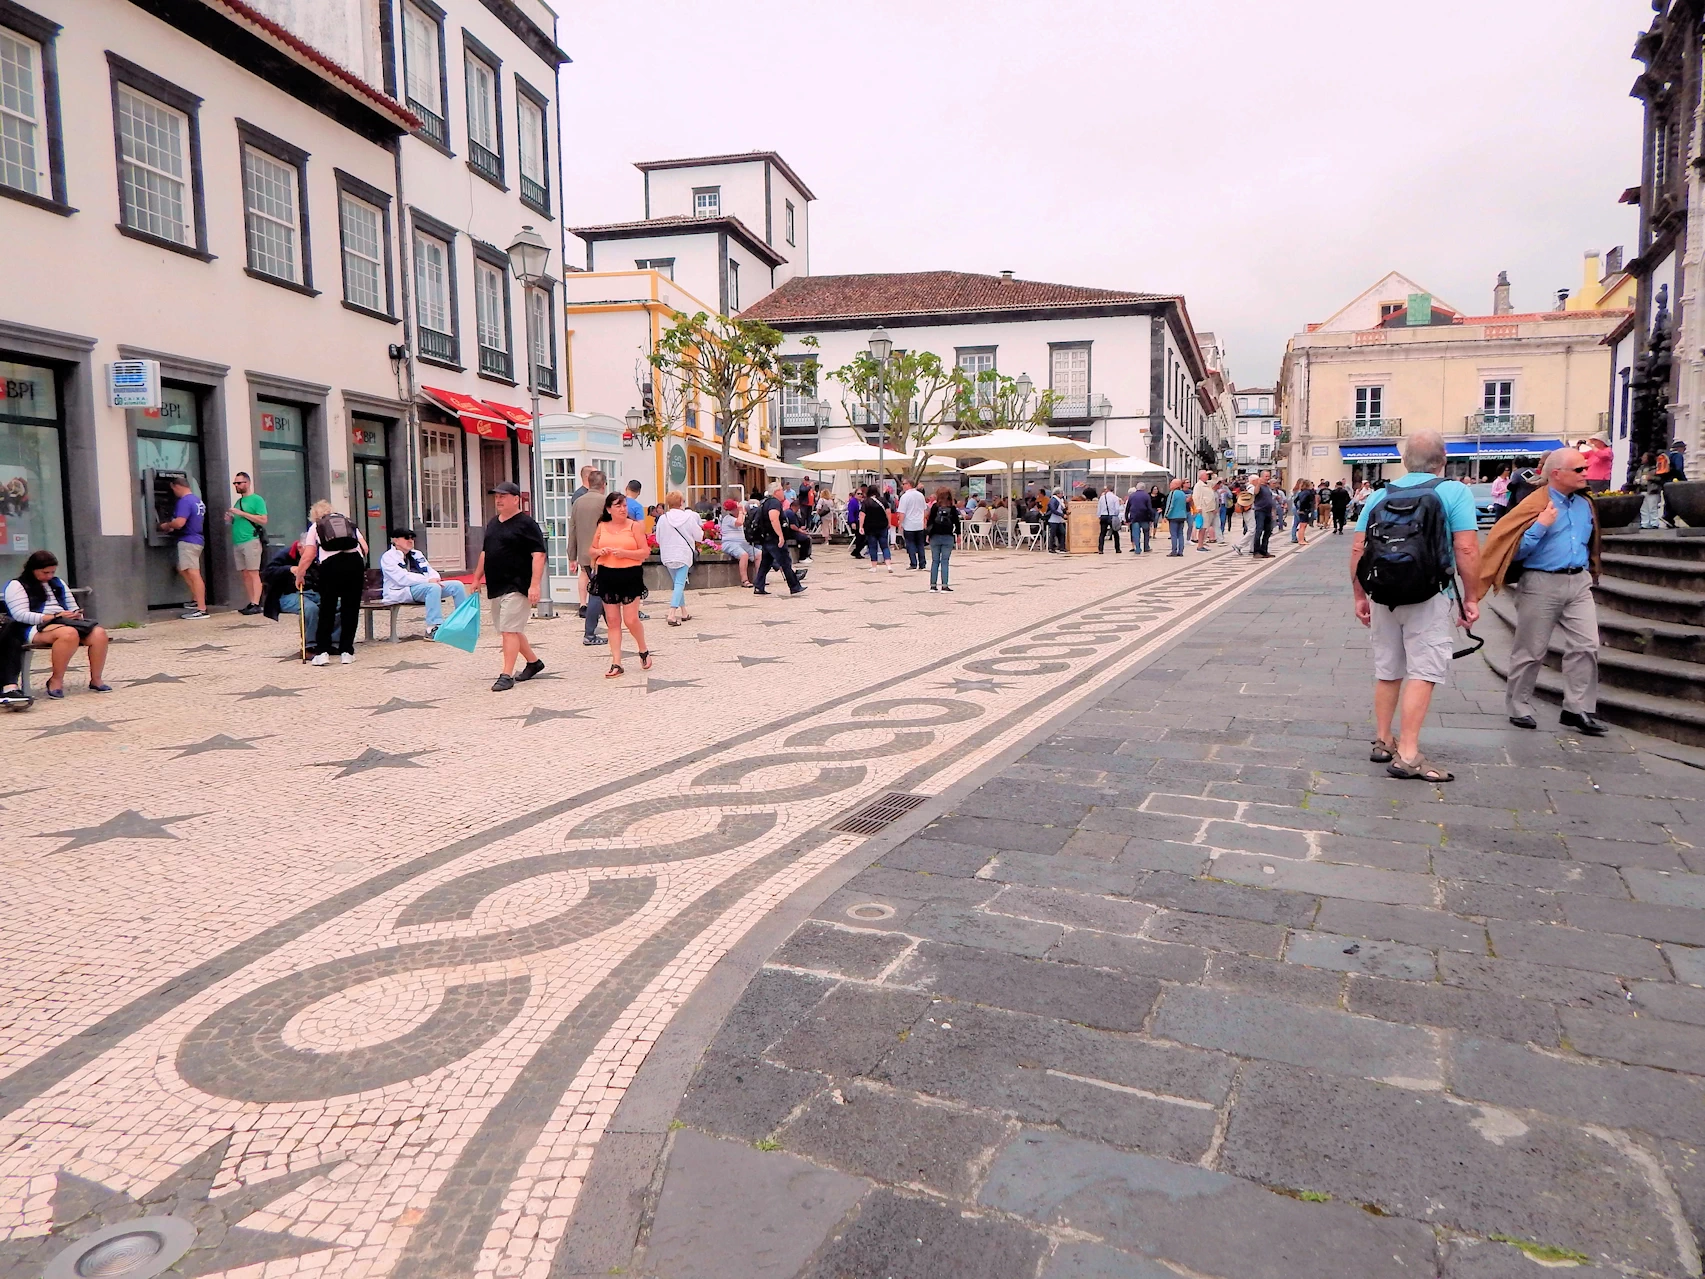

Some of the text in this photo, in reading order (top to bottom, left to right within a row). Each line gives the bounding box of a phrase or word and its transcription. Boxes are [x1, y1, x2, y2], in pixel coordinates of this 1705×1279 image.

[6, 380, 35, 400] BPI
[160, 401, 181, 418] BPI
[274, 416, 291, 431] BPI
[364, 431, 376, 443] BPI
